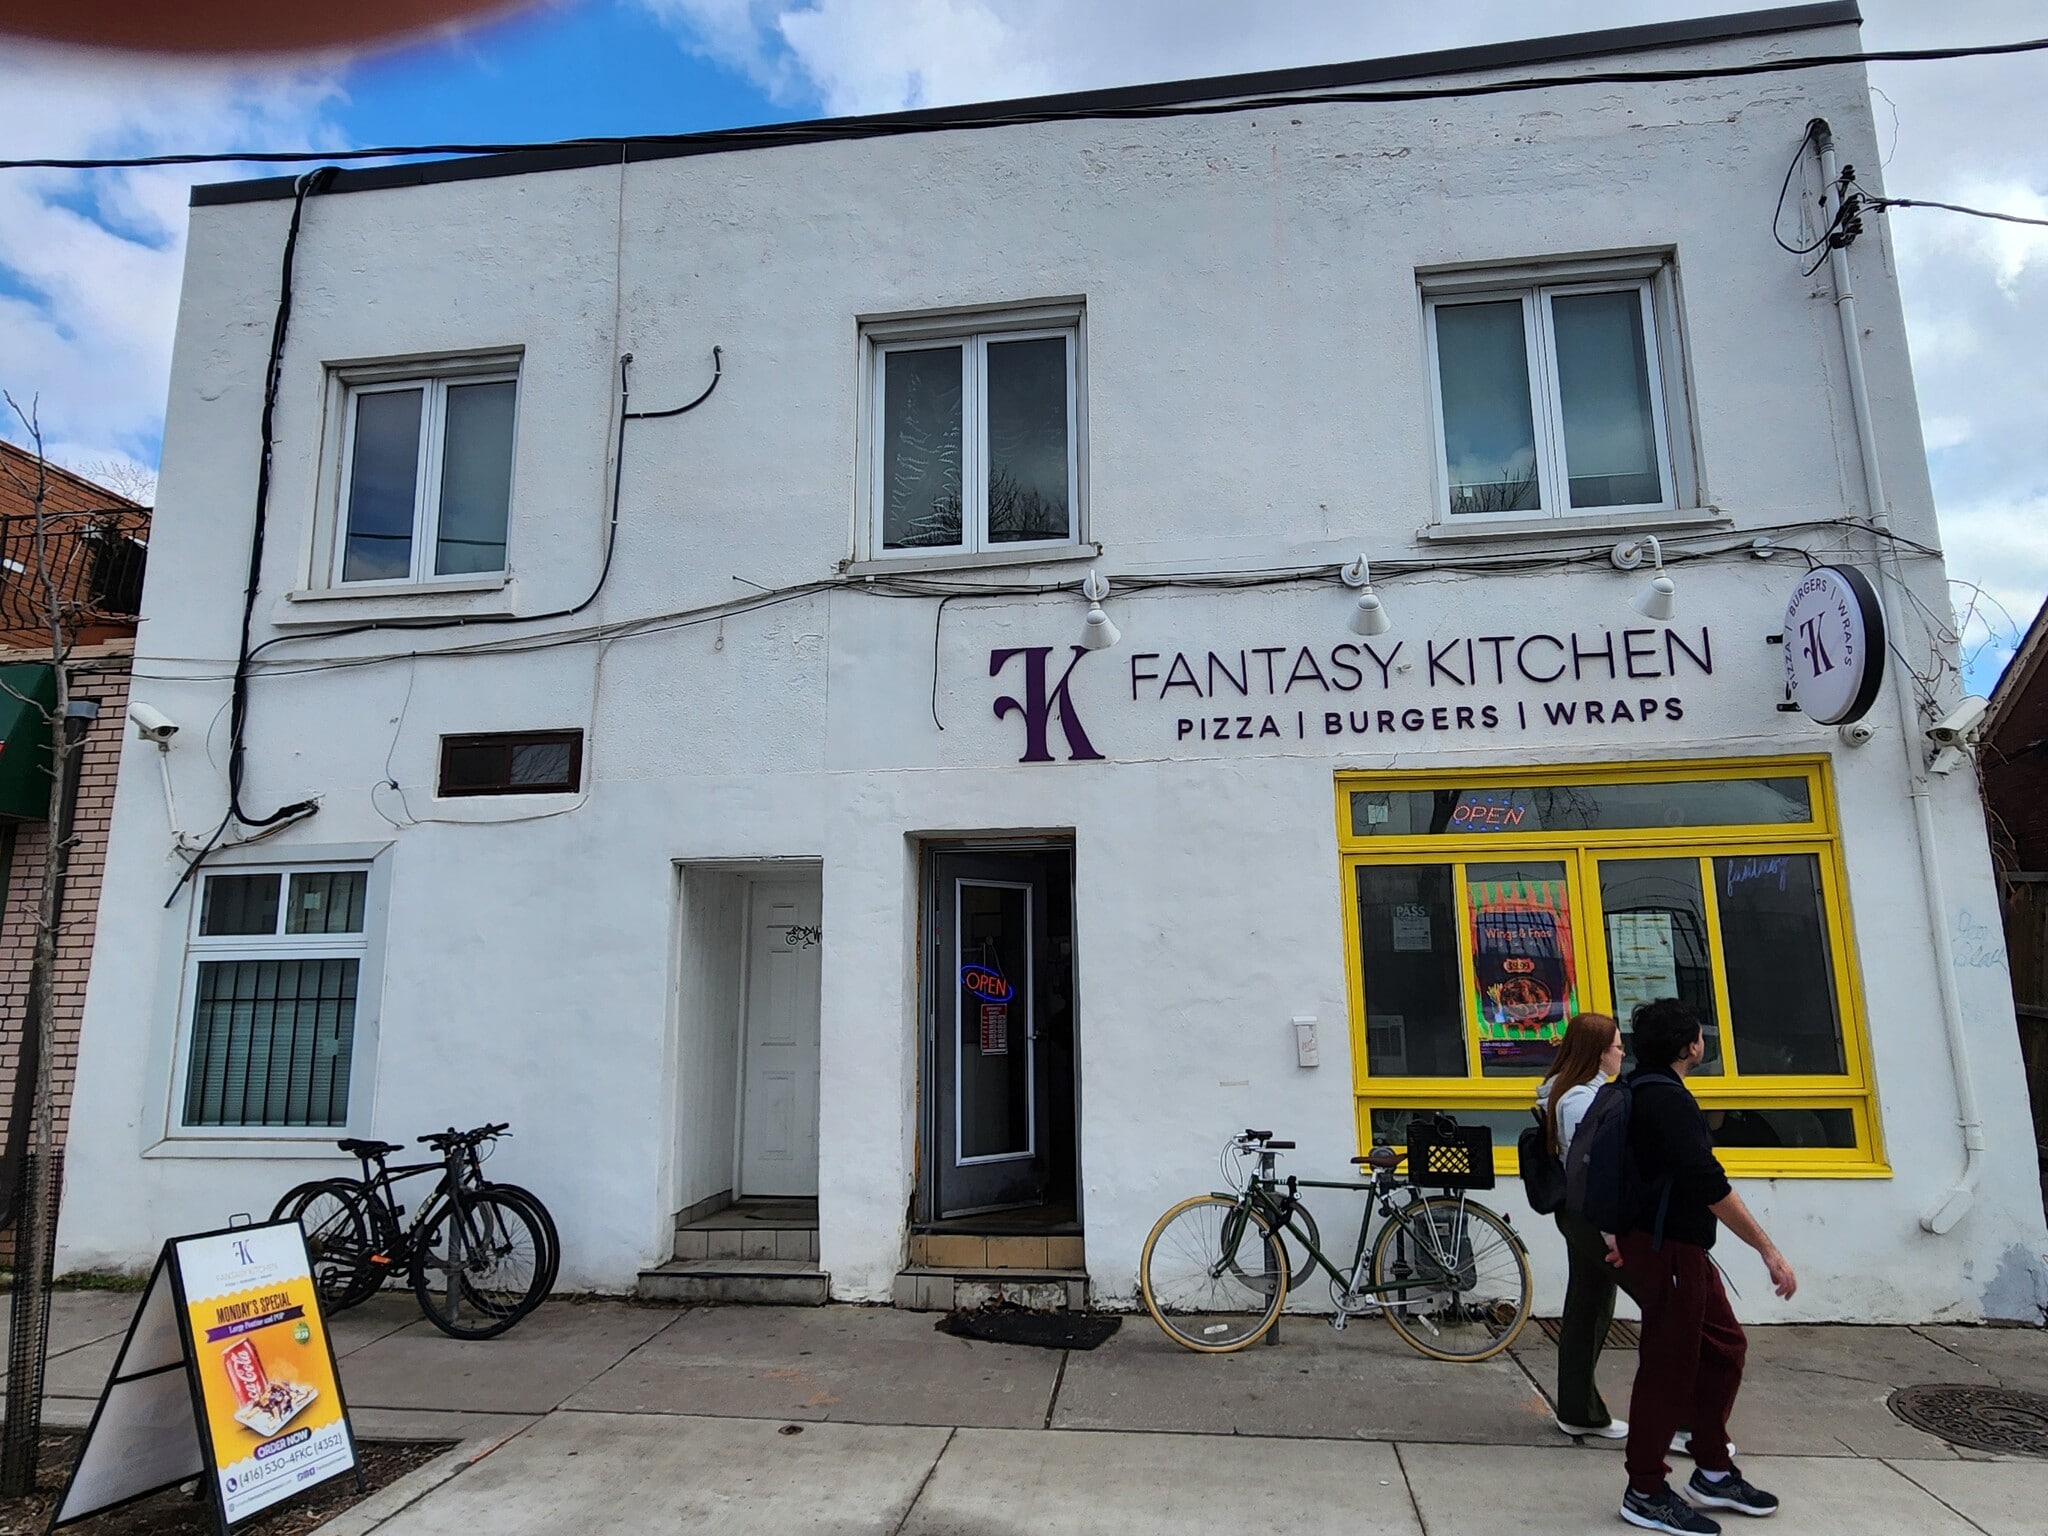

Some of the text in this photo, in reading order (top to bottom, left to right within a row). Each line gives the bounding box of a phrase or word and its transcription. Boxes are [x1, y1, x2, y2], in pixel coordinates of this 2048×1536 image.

[1789, 577, 1827, 617] BURGERS
[1837, 600, 1853, 667] WRAPS
[1131, 626, 1713, 700] FANTASY KITCHEN
[1784, 641, 1798, 689] PIZZA
[1177, 715, 1281, 741] PIZZA
[1324, 704, 1500, 736] BURGERS
[1543, 697, 1685, 726] WRAPS
[1453, 805, 1525, 825] OPEN
[1396, 905, 1426, 917] PASS
[1485, 928, 1518, 941] Wings
[966, 972, 1007, 997] OPEN
[216, 1292, 292, 1325] MONDAY'S SPECIAL
[239, 1466, 264, 1488] (416)
[265, 1446, 314, 1475] 530-4FKC
[313, 1432, 343, 1455] (4352)
[257, 1428, 309, 1459] ORDER NOW
